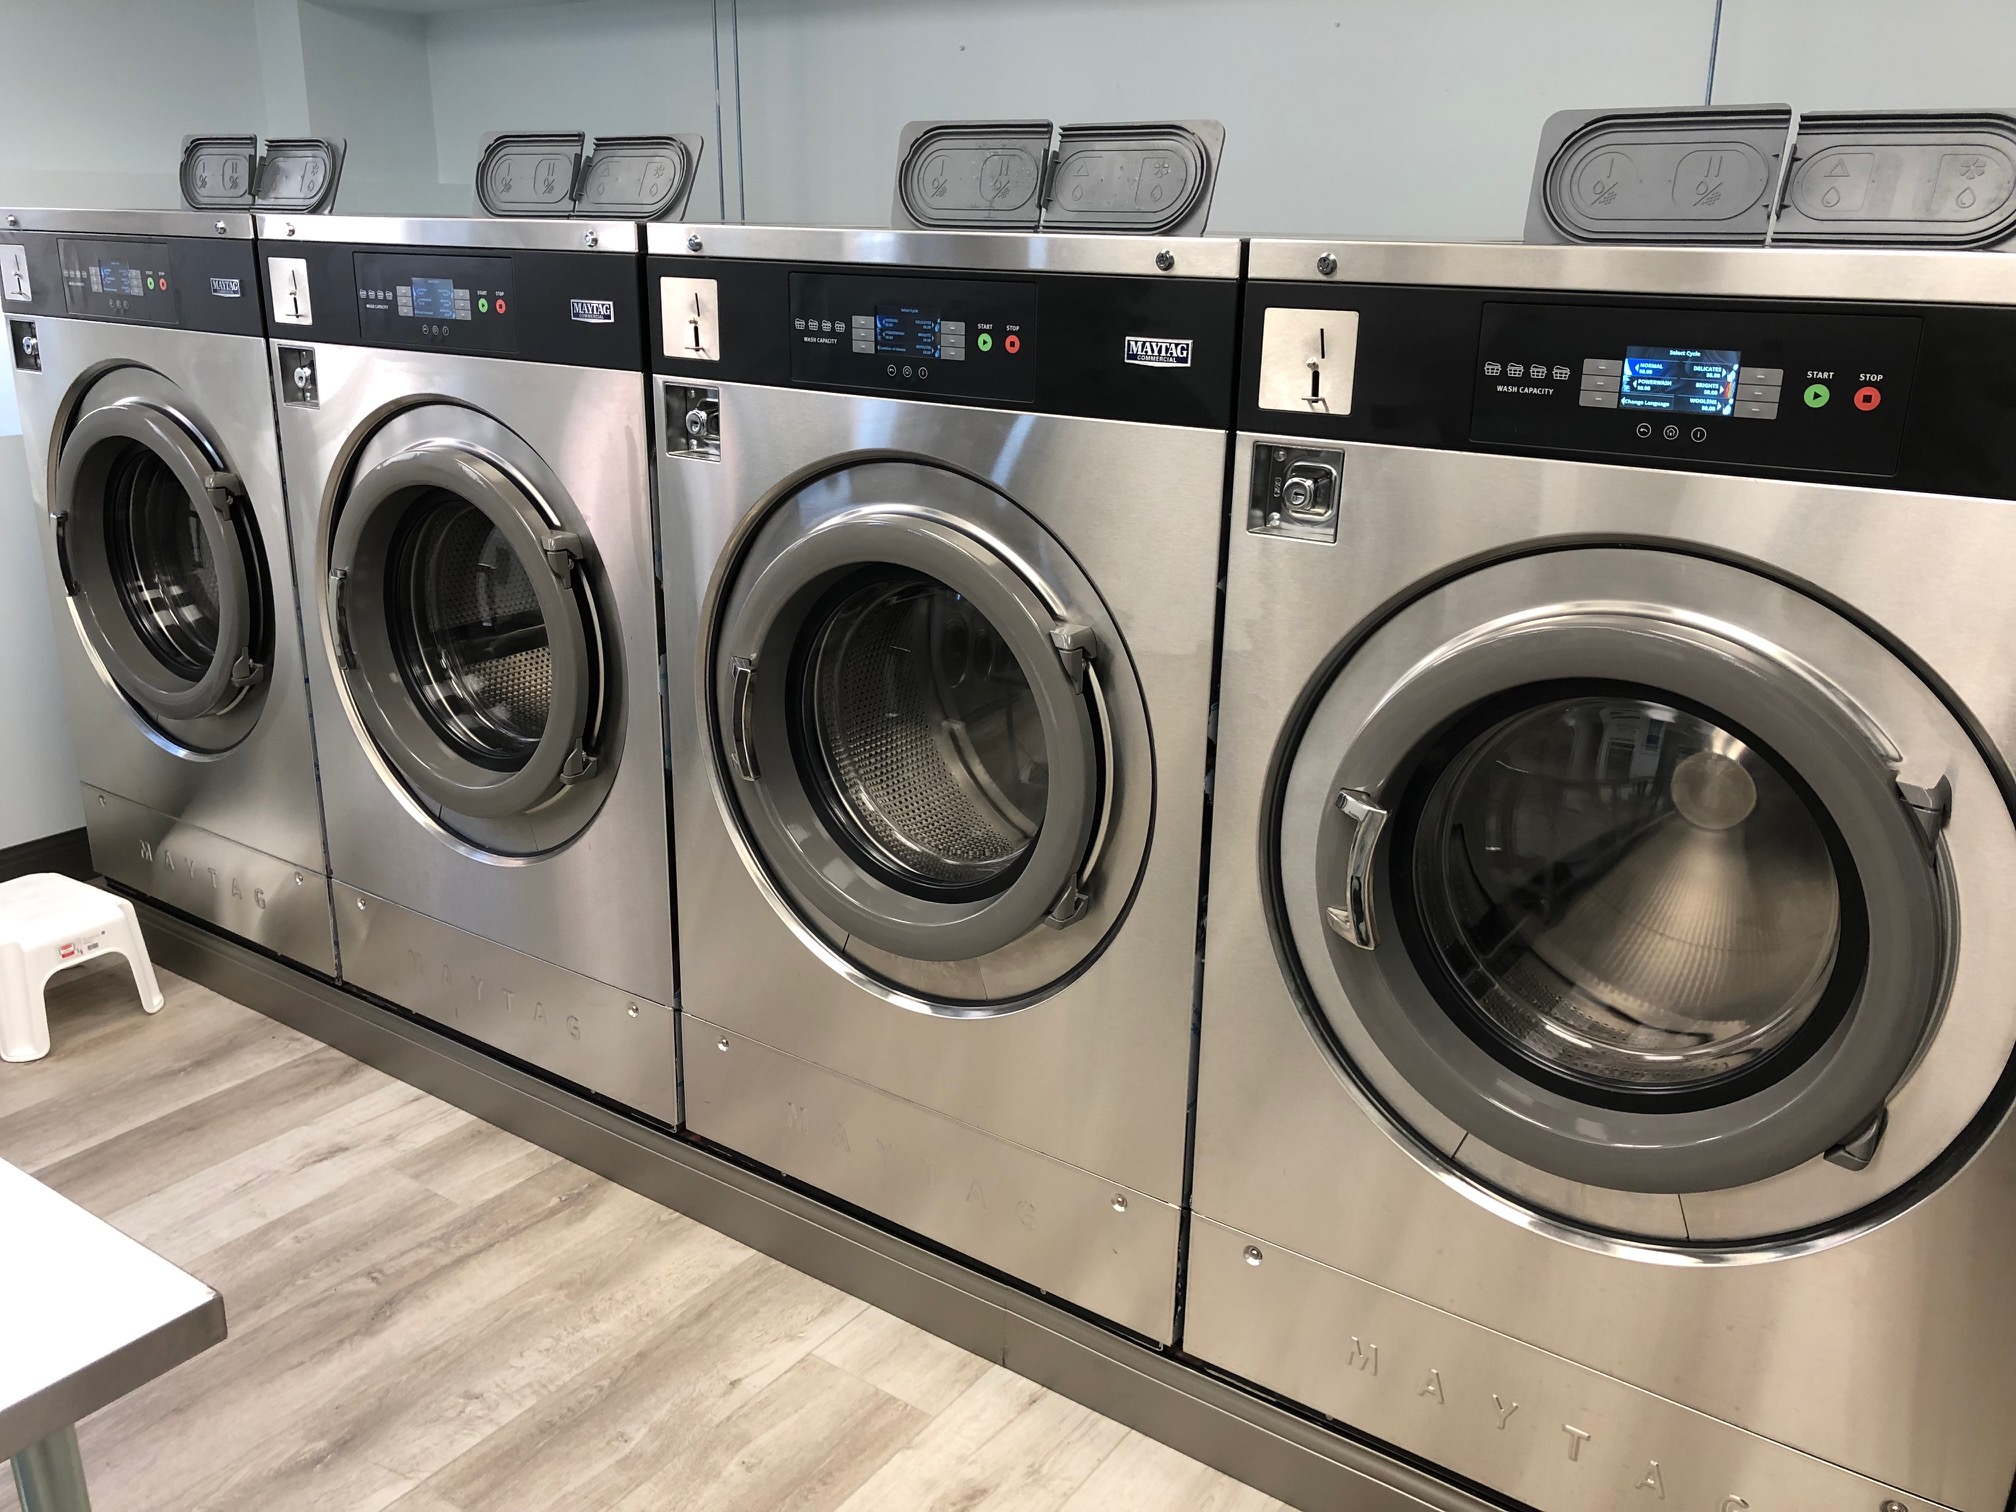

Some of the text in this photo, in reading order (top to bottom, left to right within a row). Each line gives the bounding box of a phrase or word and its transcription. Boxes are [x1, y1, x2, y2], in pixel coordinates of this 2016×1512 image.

[573, 302, 611, 316] MAYTAG
[817, 337, 838, 345] CAPACITY
[1128, 340, 1188, 358] MAYTAG
[1136, 354, 1178, 363] COMMERCIAL
[1639, 362, 1664, 370] NORMAL
[1693, 365, 1722, 373] DELICATES
[1806, 370, 1835, 380] START
[1859, 373, 1884, 382] STOP
[1637, 378, 1673, 387] POWERWASH
[1695, 382, 1720, 390] BRIGHTS
[1496, 385, 1554, 396] WASH CAPACITY
[1624, 398, 1670, 408] Change Language
[1689, 397, 1718, 405] WOOLENS
[139, 838, 267, 909] MAYTAG
[407, 948, 581, 1041] MAYTAG
